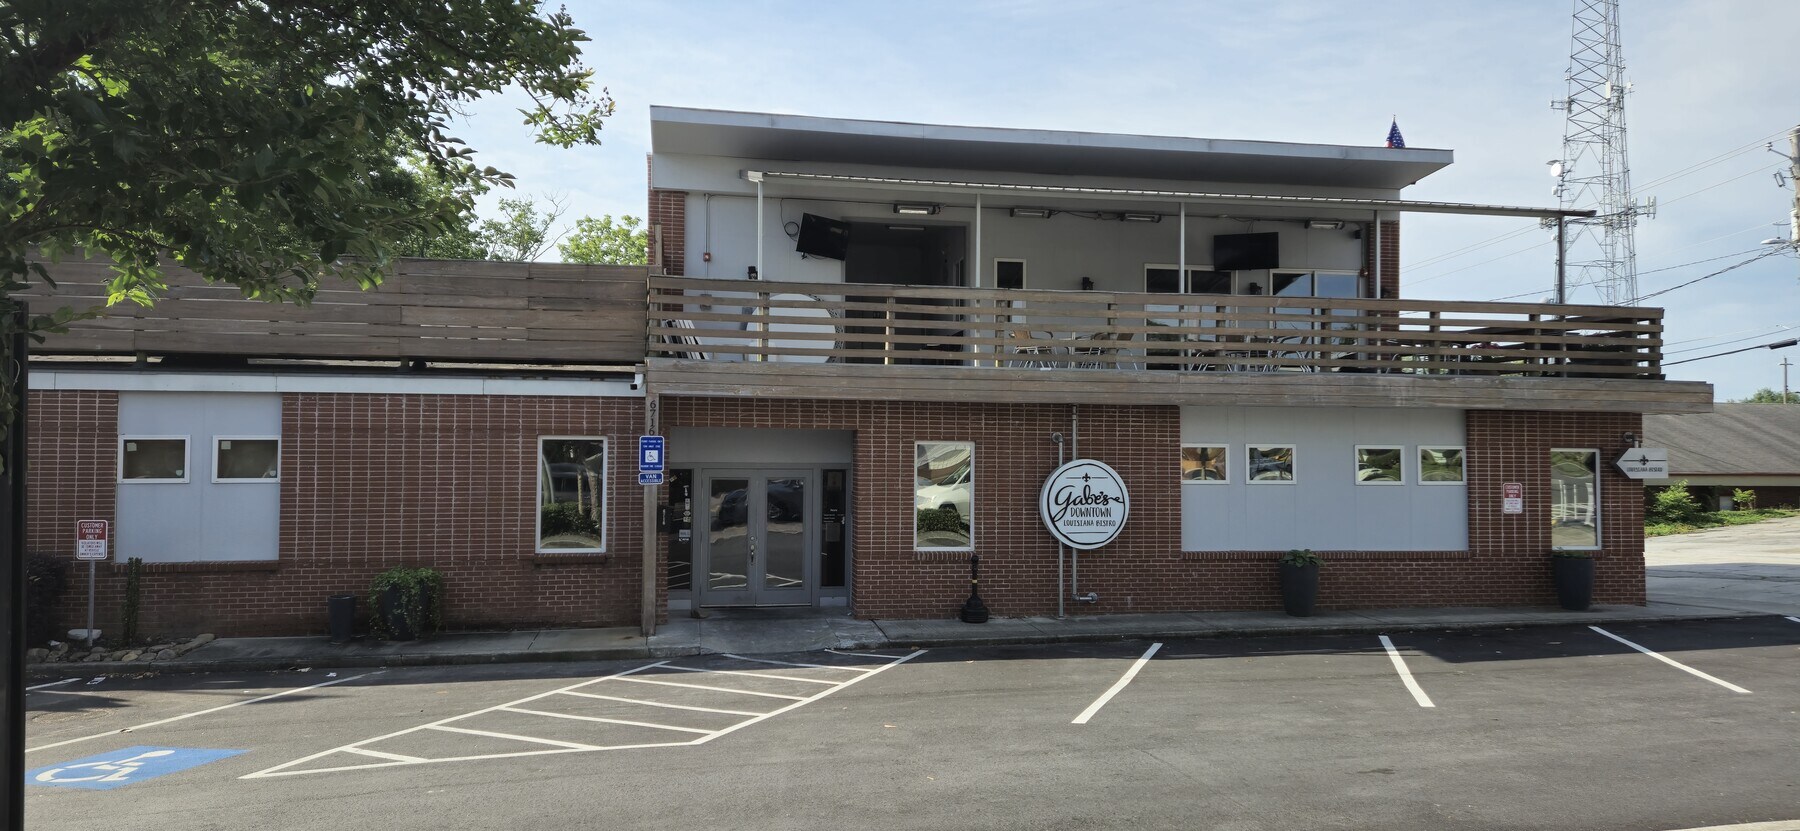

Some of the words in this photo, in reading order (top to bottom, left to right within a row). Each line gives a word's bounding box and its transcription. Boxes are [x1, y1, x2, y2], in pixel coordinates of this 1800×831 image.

[649, 400, 657, 436] 6716
[1053, 484, 1124, 522] Gabe's
[1070, 507, 1112, 518] DOWNTOWN
